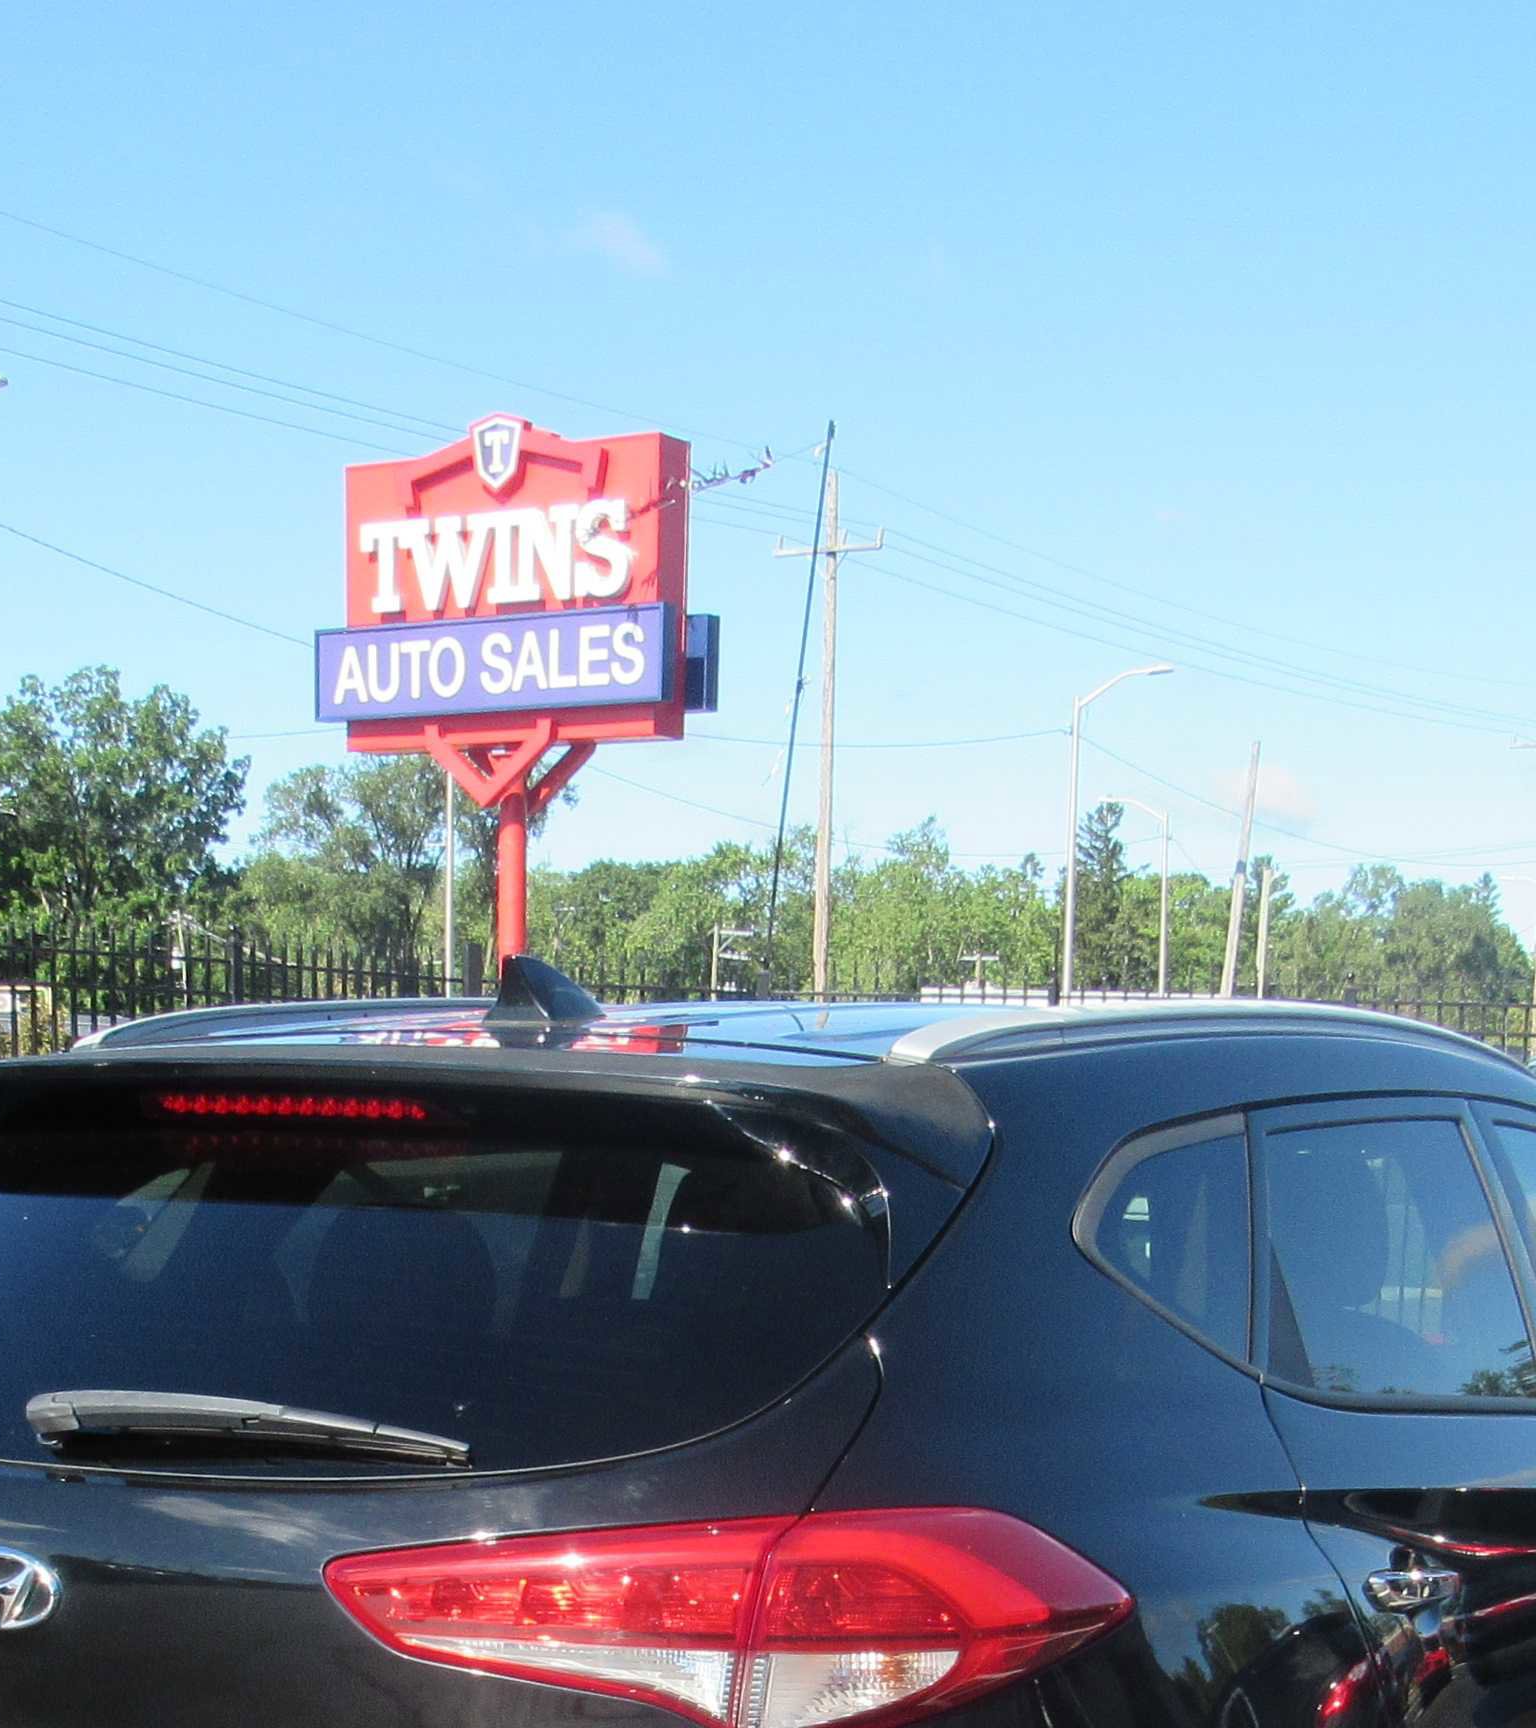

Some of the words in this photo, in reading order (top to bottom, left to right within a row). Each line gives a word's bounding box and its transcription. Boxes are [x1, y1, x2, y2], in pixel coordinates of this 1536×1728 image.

[483, 430, 510, 473] T
[359, 498, 634, 613] TWINS
[333, 636, 465, 705] AUTO
[479, 622, 645, 695] SALES
